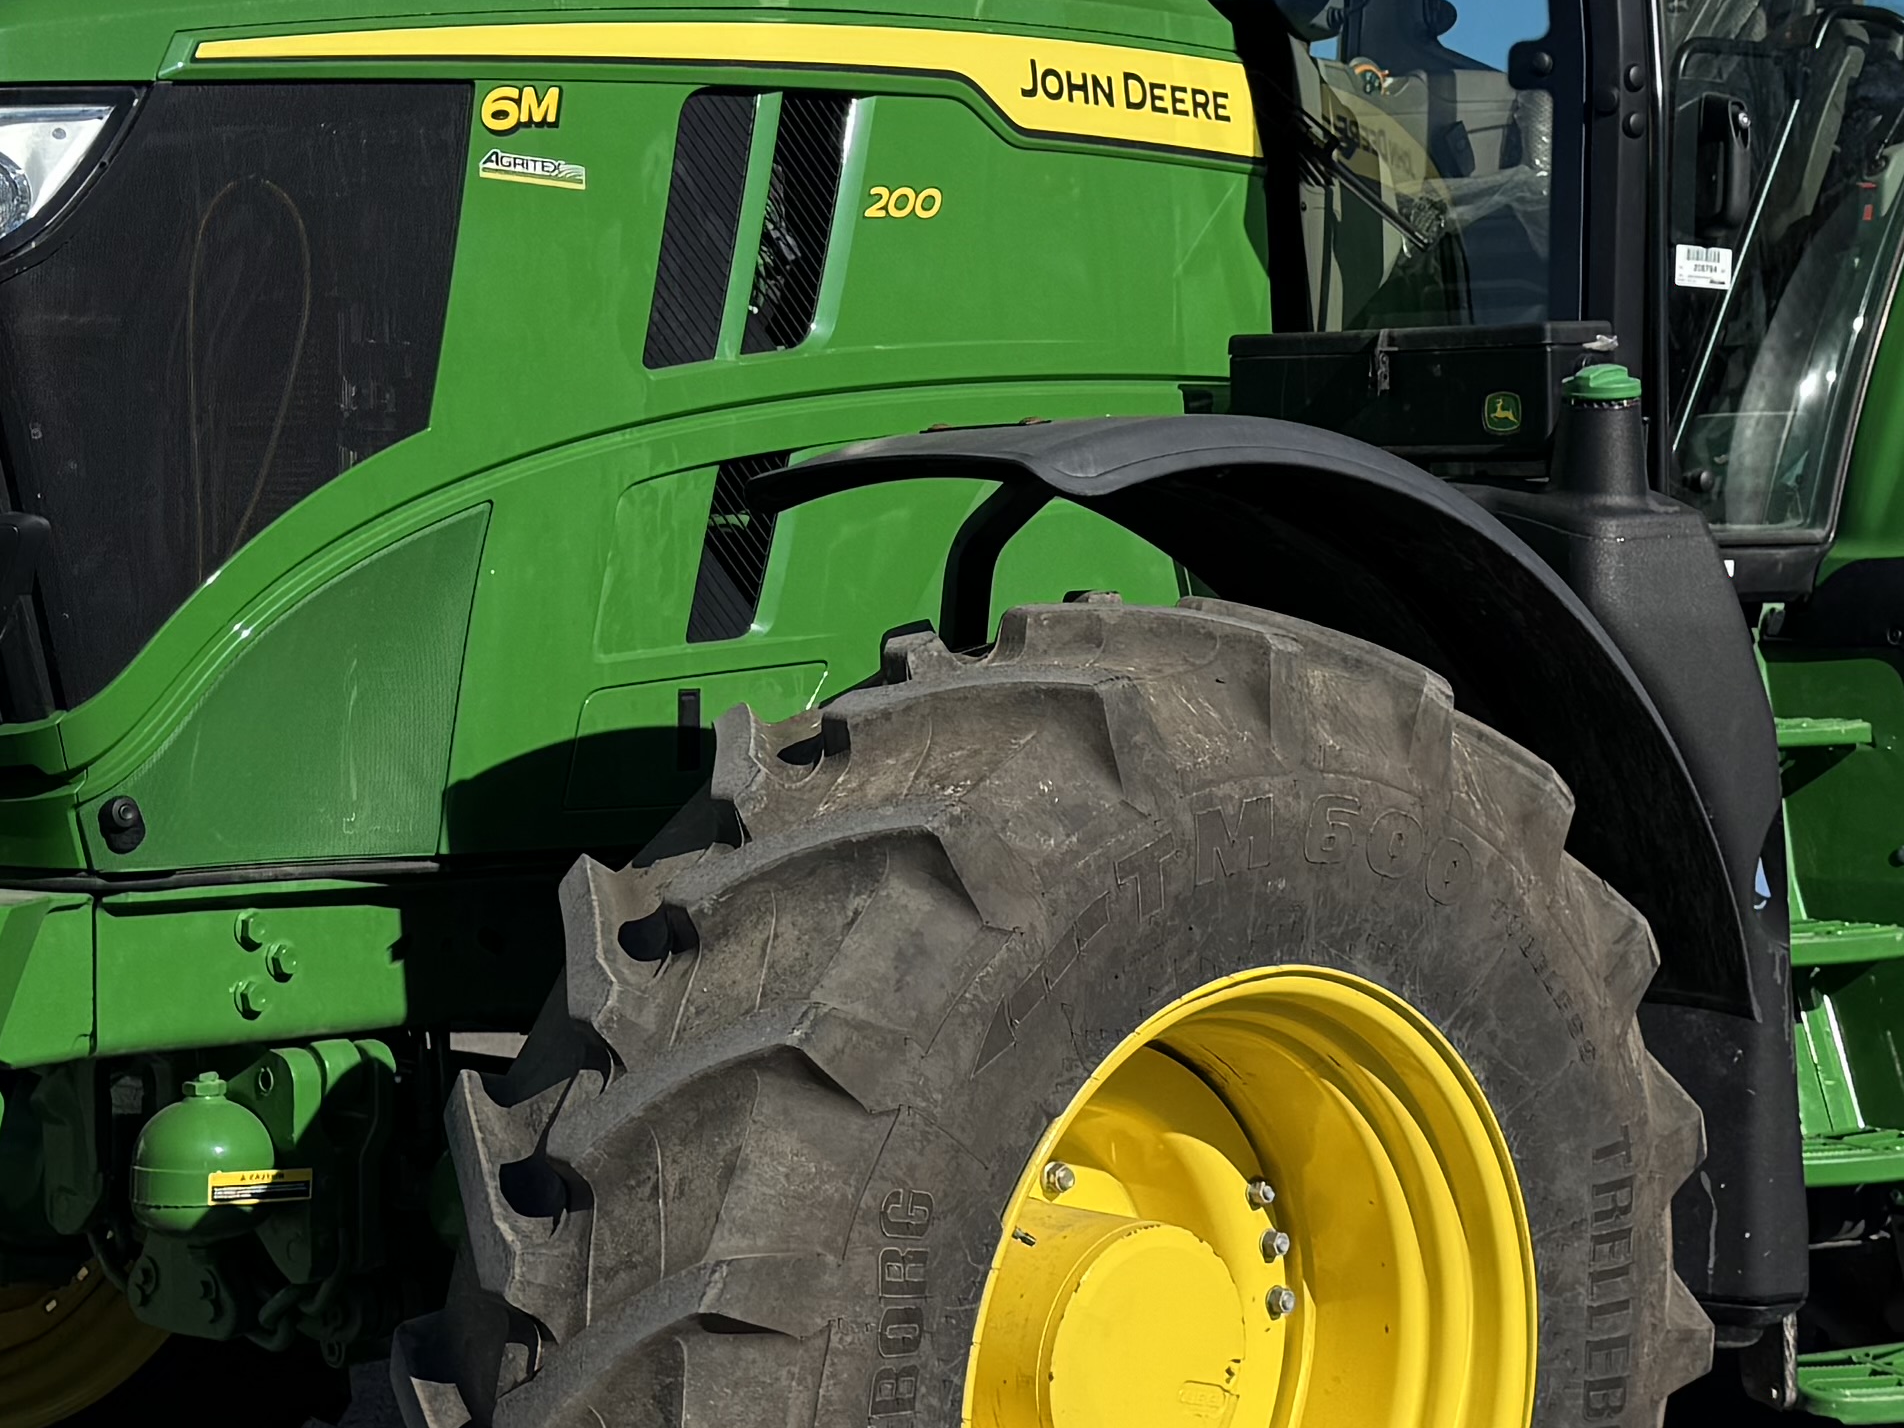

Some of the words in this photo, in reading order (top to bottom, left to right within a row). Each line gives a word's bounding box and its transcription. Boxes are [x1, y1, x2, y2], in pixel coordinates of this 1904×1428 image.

[481, 86, 561, 132] 6M
[1020, 58, 1115, 108] JOHN
[1123, 71, 1231, 122] DEERE
[864, 186, 942, 219] 200
[1114, 793, 1274, 924] TM
[1303, 793, 1475, 907] 600
